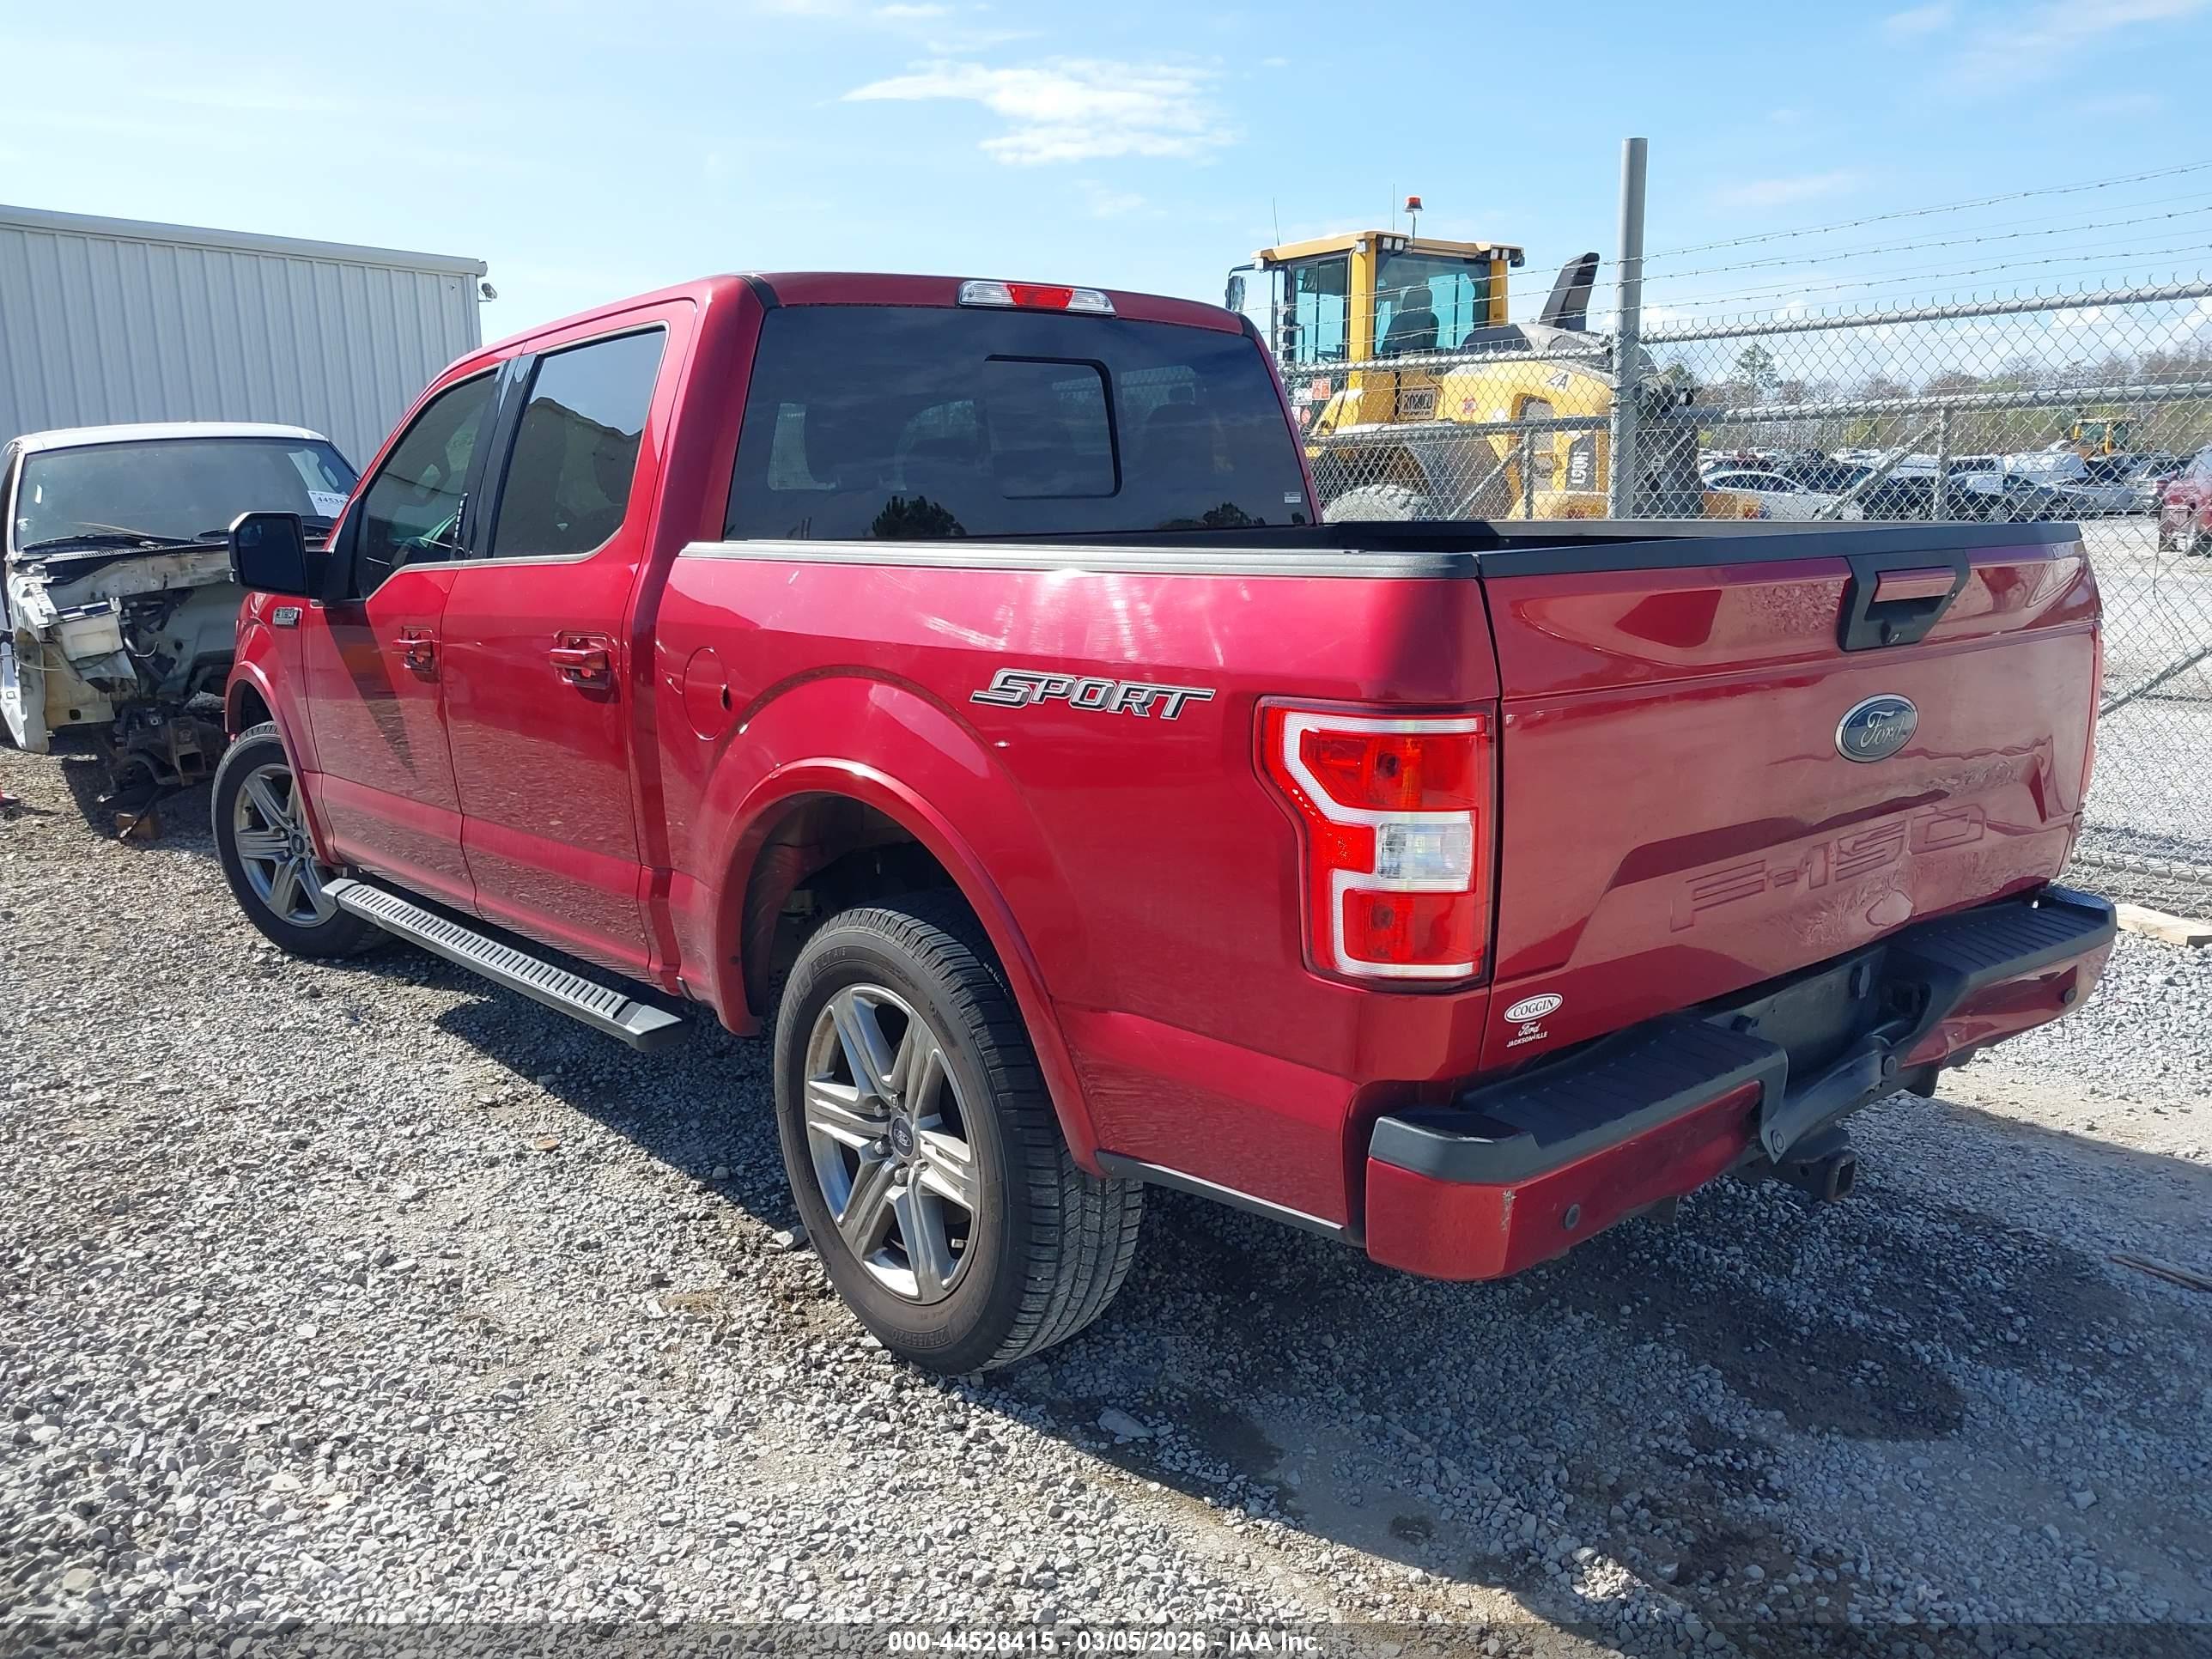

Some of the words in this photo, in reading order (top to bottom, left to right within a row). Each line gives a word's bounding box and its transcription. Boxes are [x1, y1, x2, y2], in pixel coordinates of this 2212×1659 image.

[969, 667, 1216, 720] SPORT
[1860, 710, 1905, 748] Ford
[1513, 998, 1555, 1018] COGGIN
[1518, 1021, 1542, 1036] Ford
[1506, 1031, 1548, 1048] JACKSONVILLE
